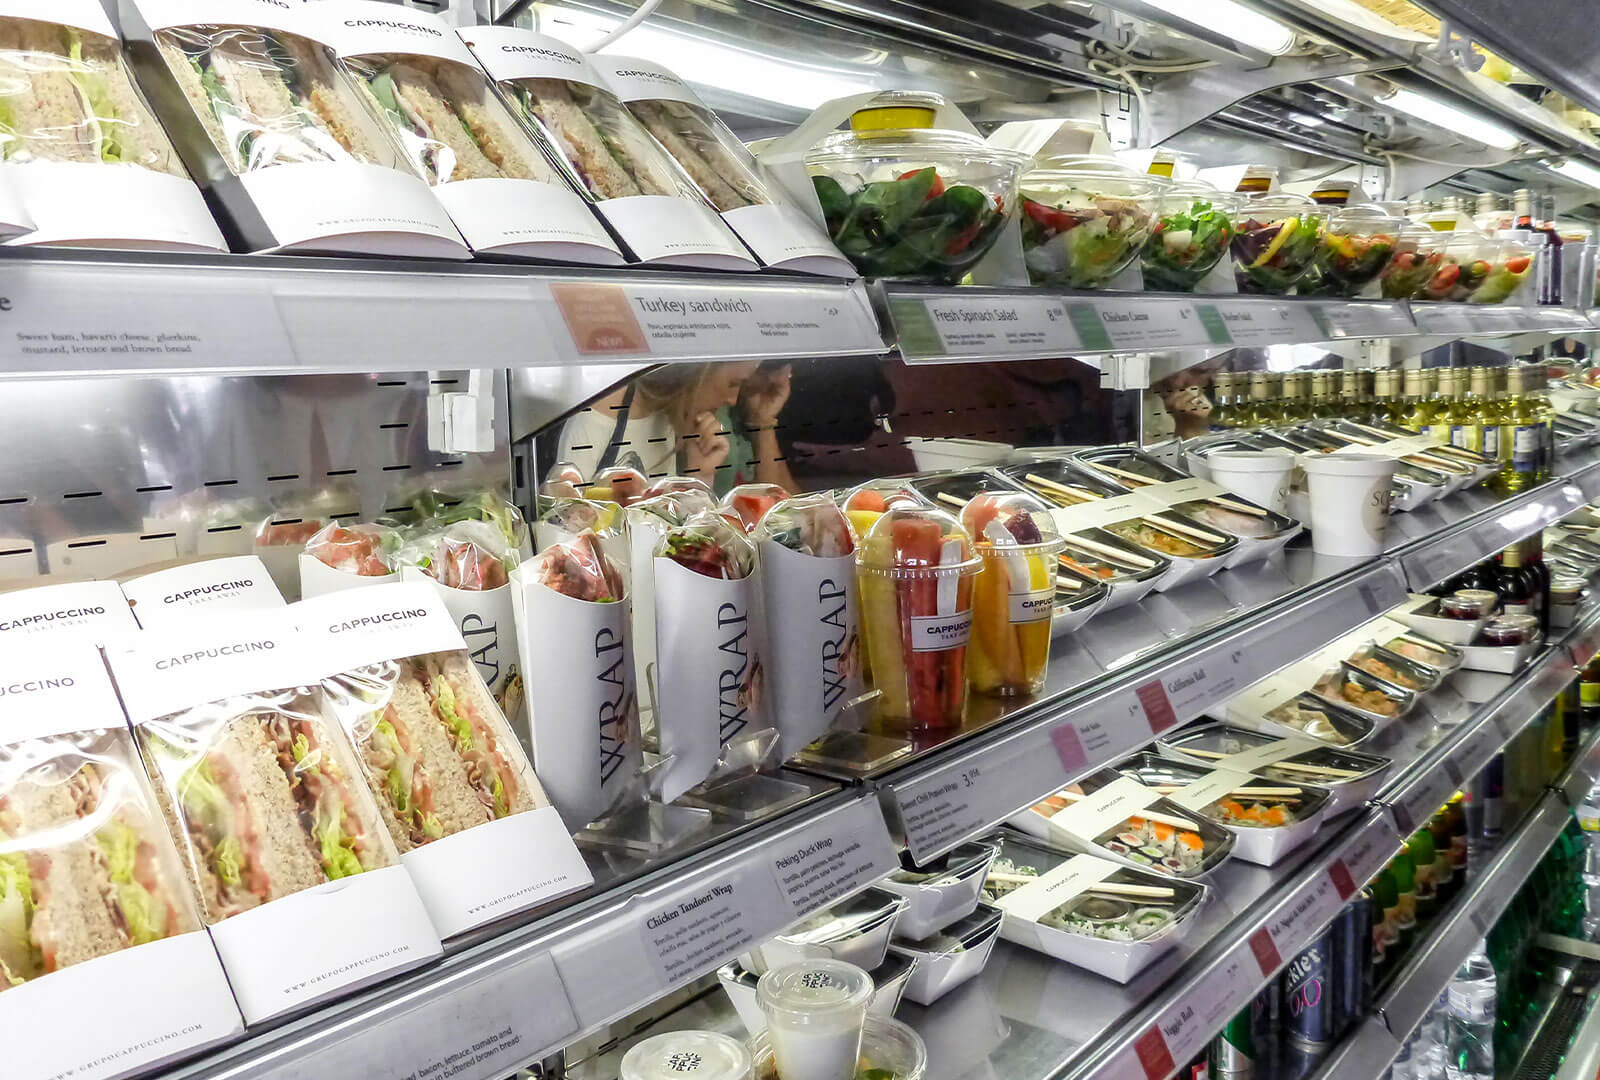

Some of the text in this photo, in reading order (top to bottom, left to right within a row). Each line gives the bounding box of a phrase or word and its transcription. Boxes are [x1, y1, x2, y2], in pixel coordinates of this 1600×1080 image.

[344, 19, 443, 37] CAPPUCCINO
[501, 44, 582, 65] CAPPUCCINO
[635, 296, 753, 316] Turkey sandwich
[933, 309, 960, 322] Fresh
[960, 309, 993, 324] Spinach
[994, 309, 1019, 322] Salad
[163, 579, 254, 605] CAPPUCCINO
[0, 606, 106, 632] CAPPUCCINO
[328, 608, 428, 634] CAPPUCCINO
[154, 639, 276, 671] CAPPUCCINO
[461, 613, 499, 688] AP
[818, 578, 848, 713] WRAP
[717, 601, 749, 749] WRAP
[595, 627, 626, 789] WRAP
[775, 837, 833, 870] Peking Duck Wrap
[646, 883, 734, 930] Chicken Tandoori Wrap
[418, 1060, 445, 1078] bacon,
[471, 1034, 499, 1052] tomato
[499, 1025, 513, 1039] and
[443, 1056, 476, 1079] buttered
[475, 1046, 500, 1062] brown
[499, 1034, 521, 1051] bread
